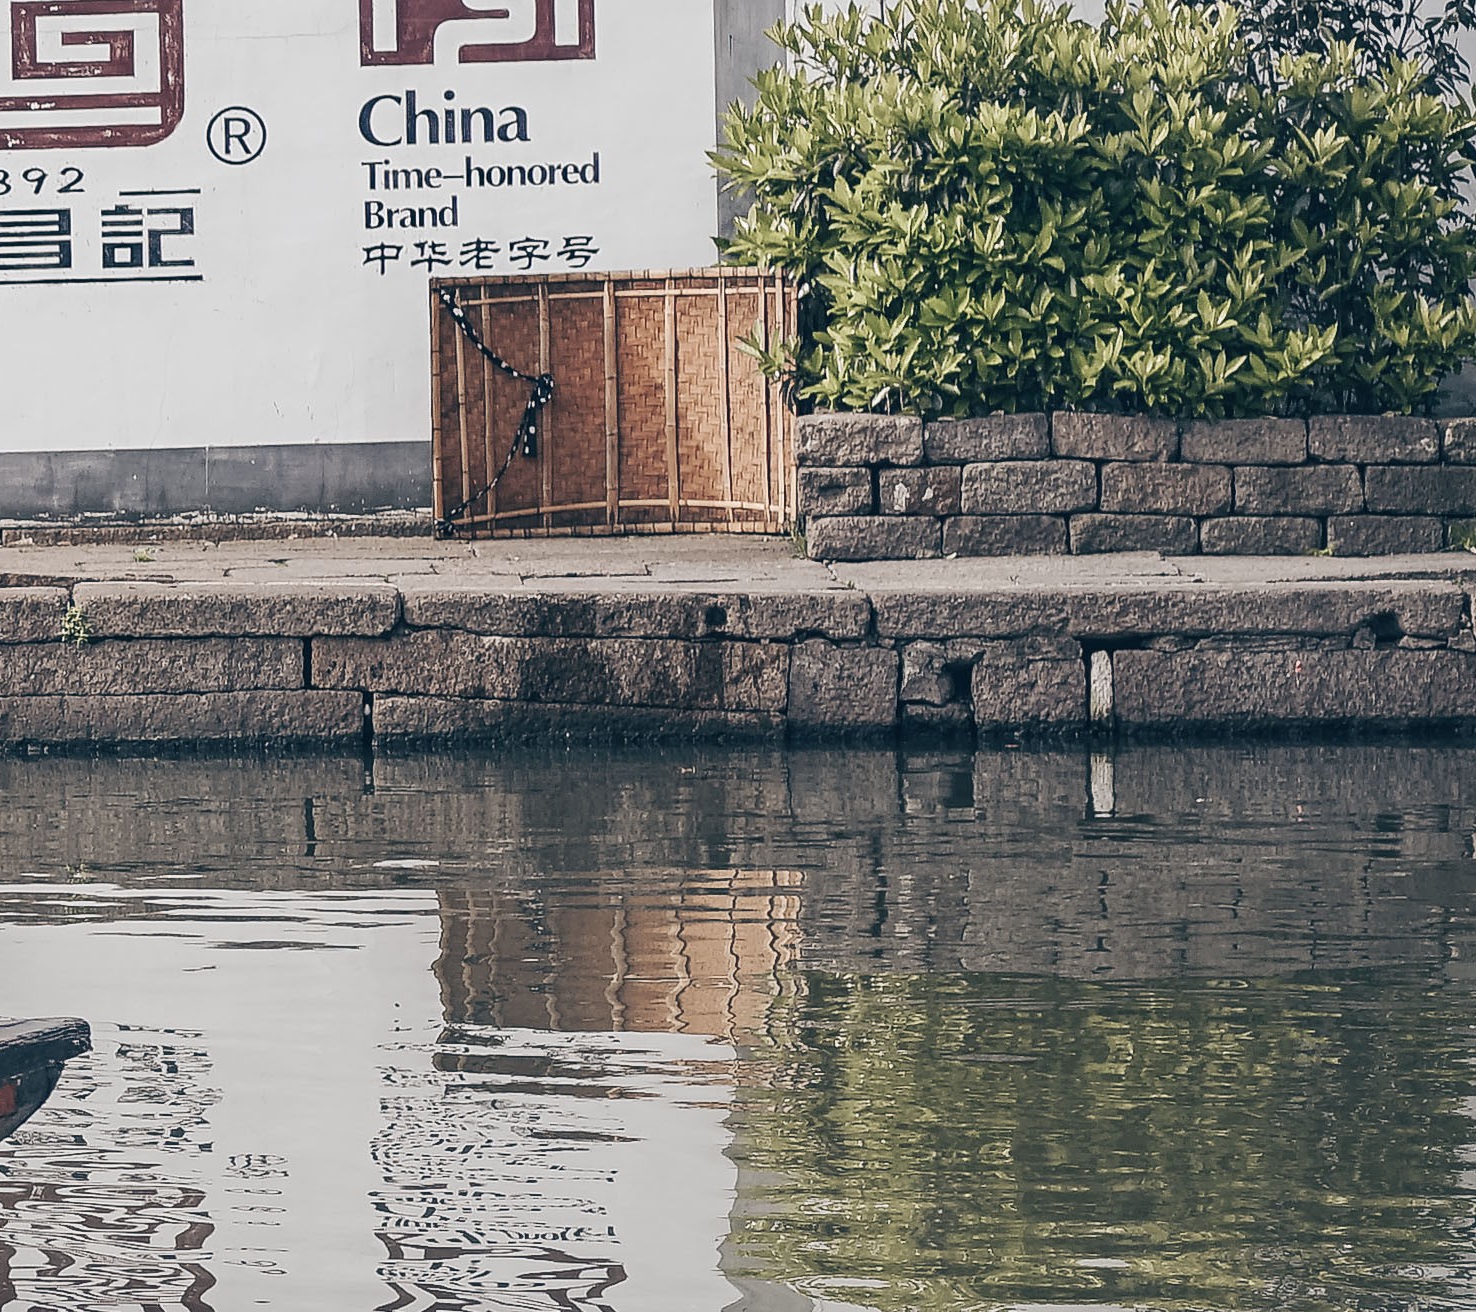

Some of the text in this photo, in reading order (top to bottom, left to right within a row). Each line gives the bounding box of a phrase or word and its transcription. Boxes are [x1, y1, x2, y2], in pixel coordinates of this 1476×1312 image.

[359, 89, 531, 147] China
[361, 152, 600, 190] Time-honored
[364, 195, 458, 229] Brand
[362, 236, 600, 276] 中华老字号
